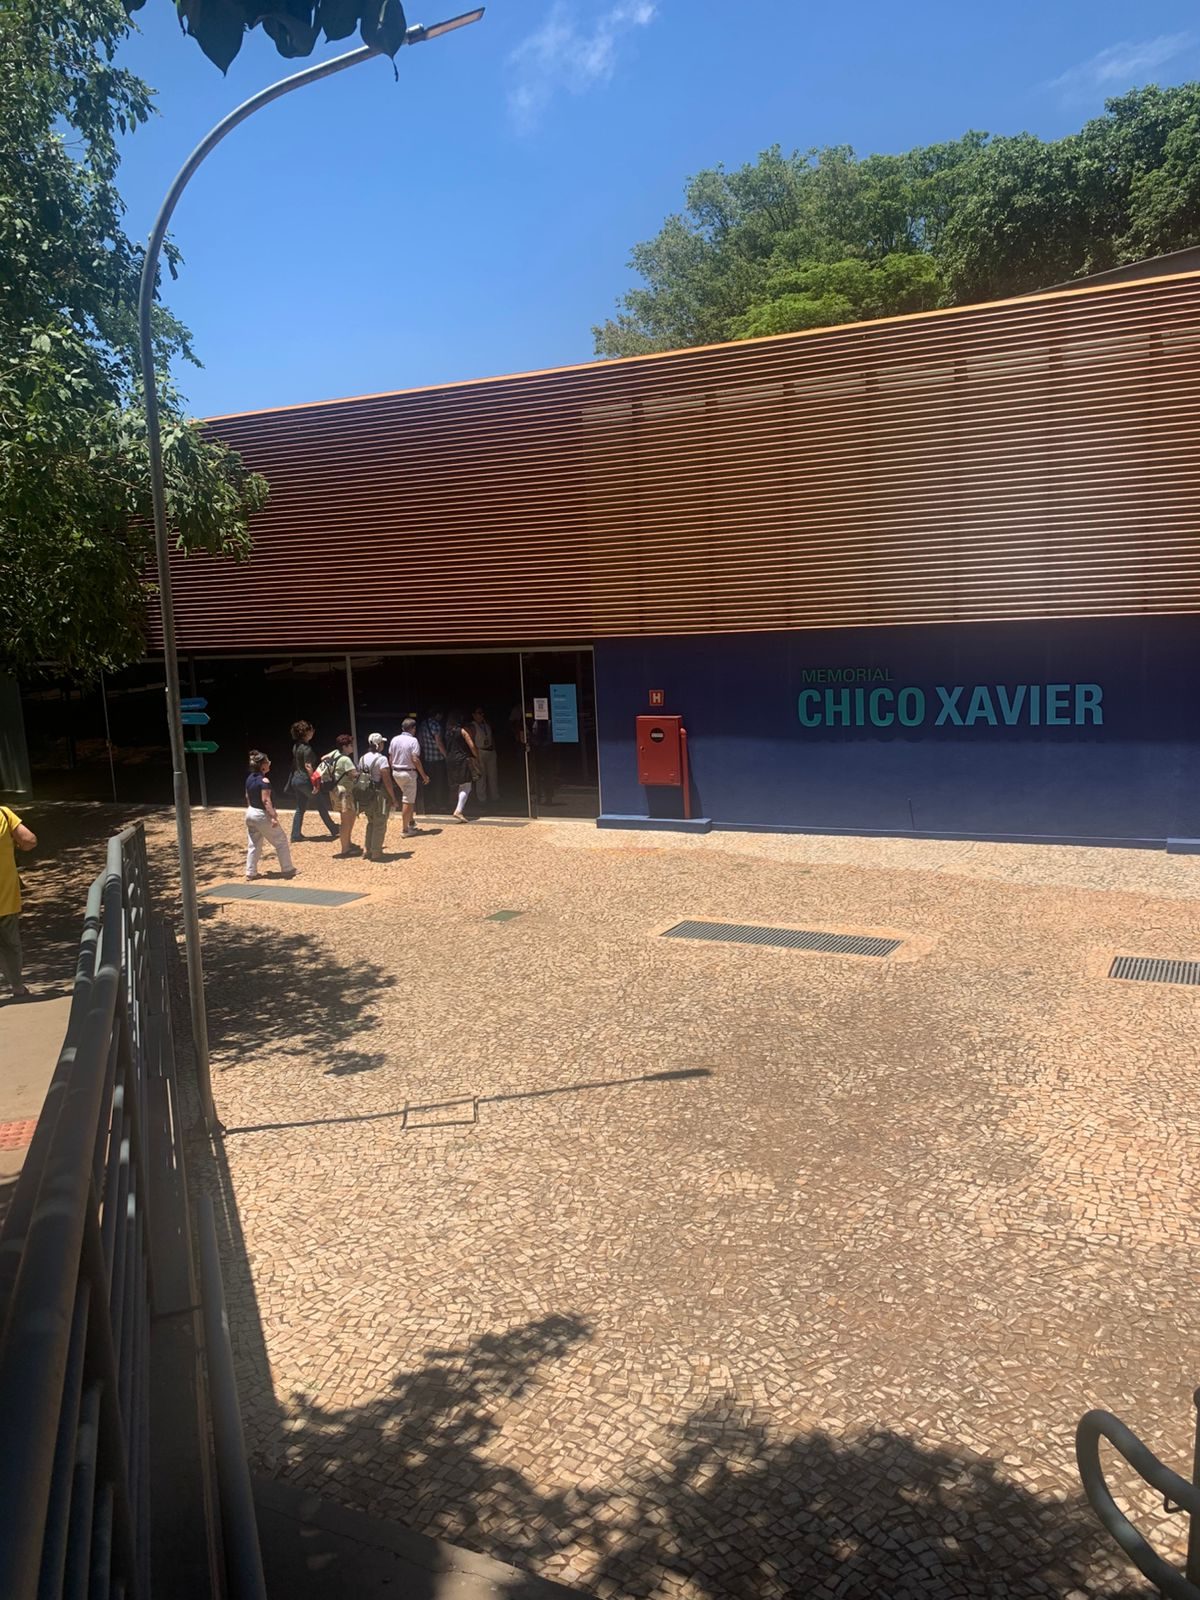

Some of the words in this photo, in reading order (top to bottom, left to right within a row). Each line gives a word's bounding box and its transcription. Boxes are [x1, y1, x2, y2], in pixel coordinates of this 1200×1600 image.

[801, 667, 894, 683] MEMORIAL
[652, 692, 661, 704] H
[798, 687, 926, 727] CHICO
[934, 683, 1104, 726] XAVIER
